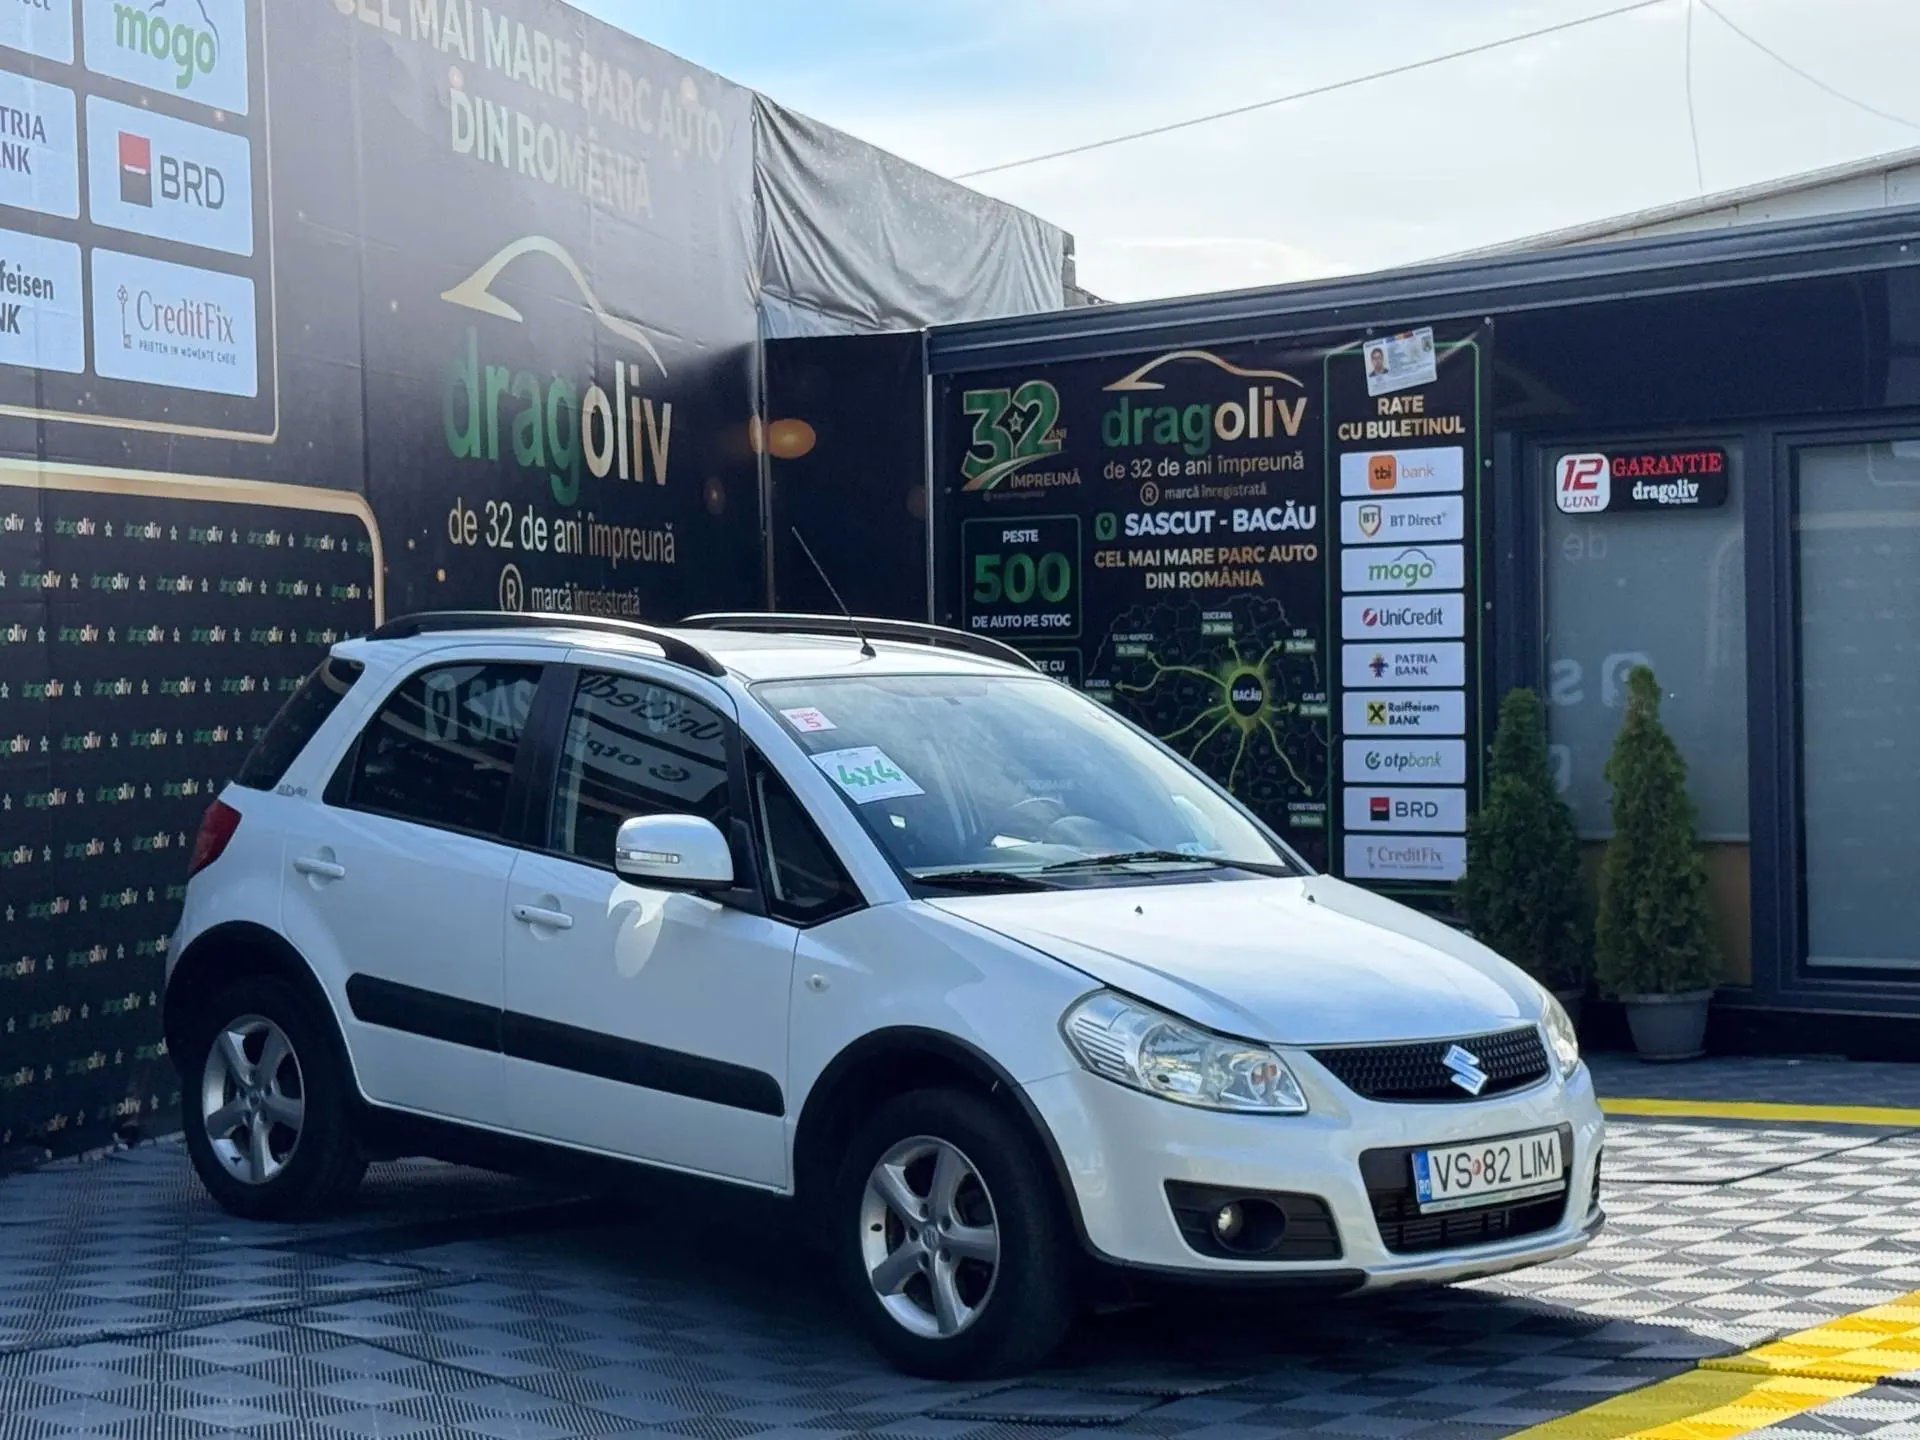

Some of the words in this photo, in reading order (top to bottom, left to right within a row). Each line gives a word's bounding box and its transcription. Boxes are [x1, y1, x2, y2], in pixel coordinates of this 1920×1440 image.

[114, 3, 216, 89] mogo
[409, 0, 476, 62] MAI
[482, 7, 577, 100] MARE
[579, 51, 653, 135] PARC
[659, 90, 724, 164] AUTO
[449, 88, 510, 168] DIN
[160, 155, 225, 210] BRD
[136, 290, 235, 344] CreditFix
[442, 326, 673, 506] dragoliv
[1378, 395, 1424, 415] RATE
[961, 380, 1062, 479] 32
[1101, 386, 1308, 456] dragoliv
[1338, 421, 1363, 440] CU
[1366, 415, 1465, 439] BULETINUL
[1103, 461, 1125, 480] de
[1130, 458, 1152, 478] 32
[1157, 457, 1180, 477] de
[1185, 455, 1212, 476] ani
[1217, 450, 1305, 477] împreună
[1374, 465, 1392, 480] tbi
[1402, 464, 1434, 478] bank
[1562, 458, 1604, 491] 12
[1612, 452, 1722, 477] GARANTIE
[1563, 495, 1601, 509] LUNI
[1632, 479, 1699, 503] dragoliv
[1124, 509, 1216, 536] SASCUT
[1232, 499, 1317, 532] BACĂU
[1363, 512, 1377, 523] BT
[1390, 514, 1405, 527] BT
[449, 496, 477, 546] de
[485, 500, 514, 549] 32
[520, 505, 548, 552] de
[554, 511, 582, 555] ani
[587, 512, 675, 569] împreună
[1002, 529, 1039, 543] PESTE
[1094, 551, 1126, 568] CEL
[1128, 549, 1161, 567] MAI
[1164, 547, 1215, 566] MARE
[1218, 546, 1265, 564] PARC
[1268, 544, 1318, 563] AUTO
[973, 552, 1071, 604] 500
[1145, 572, 1176, 590] DIN
[1179, 566, 1264, 590] ROMÂNIA
[1369, 563, 1433, 587] mogo
[532, 582, 573, 611] marcă
[972, 615, 988, 628] DE
[990, 615, 1022, 628] AUTO
[1024, 614, 1039, 627] PE
[1040, 614, 1071, 627] STOC
[1379, 608, 1443, 626] UniCredit
[1395, 653, 1438, 664] PATRIA
[1395, 665, 1429, 676] BANK
[1388, 701, 1440, 712] Raiffeisen
[1389, 714, 1420, 725] BANK
[1384, 752, 1442, 772] otpbank
[1395, 802, 1438, 818] BRD
[1434, 1152, 1473, 1192] VS
[1483, 1146, 1511, 1185] 82
[1519, 1138, 1555, 1180] LIM
